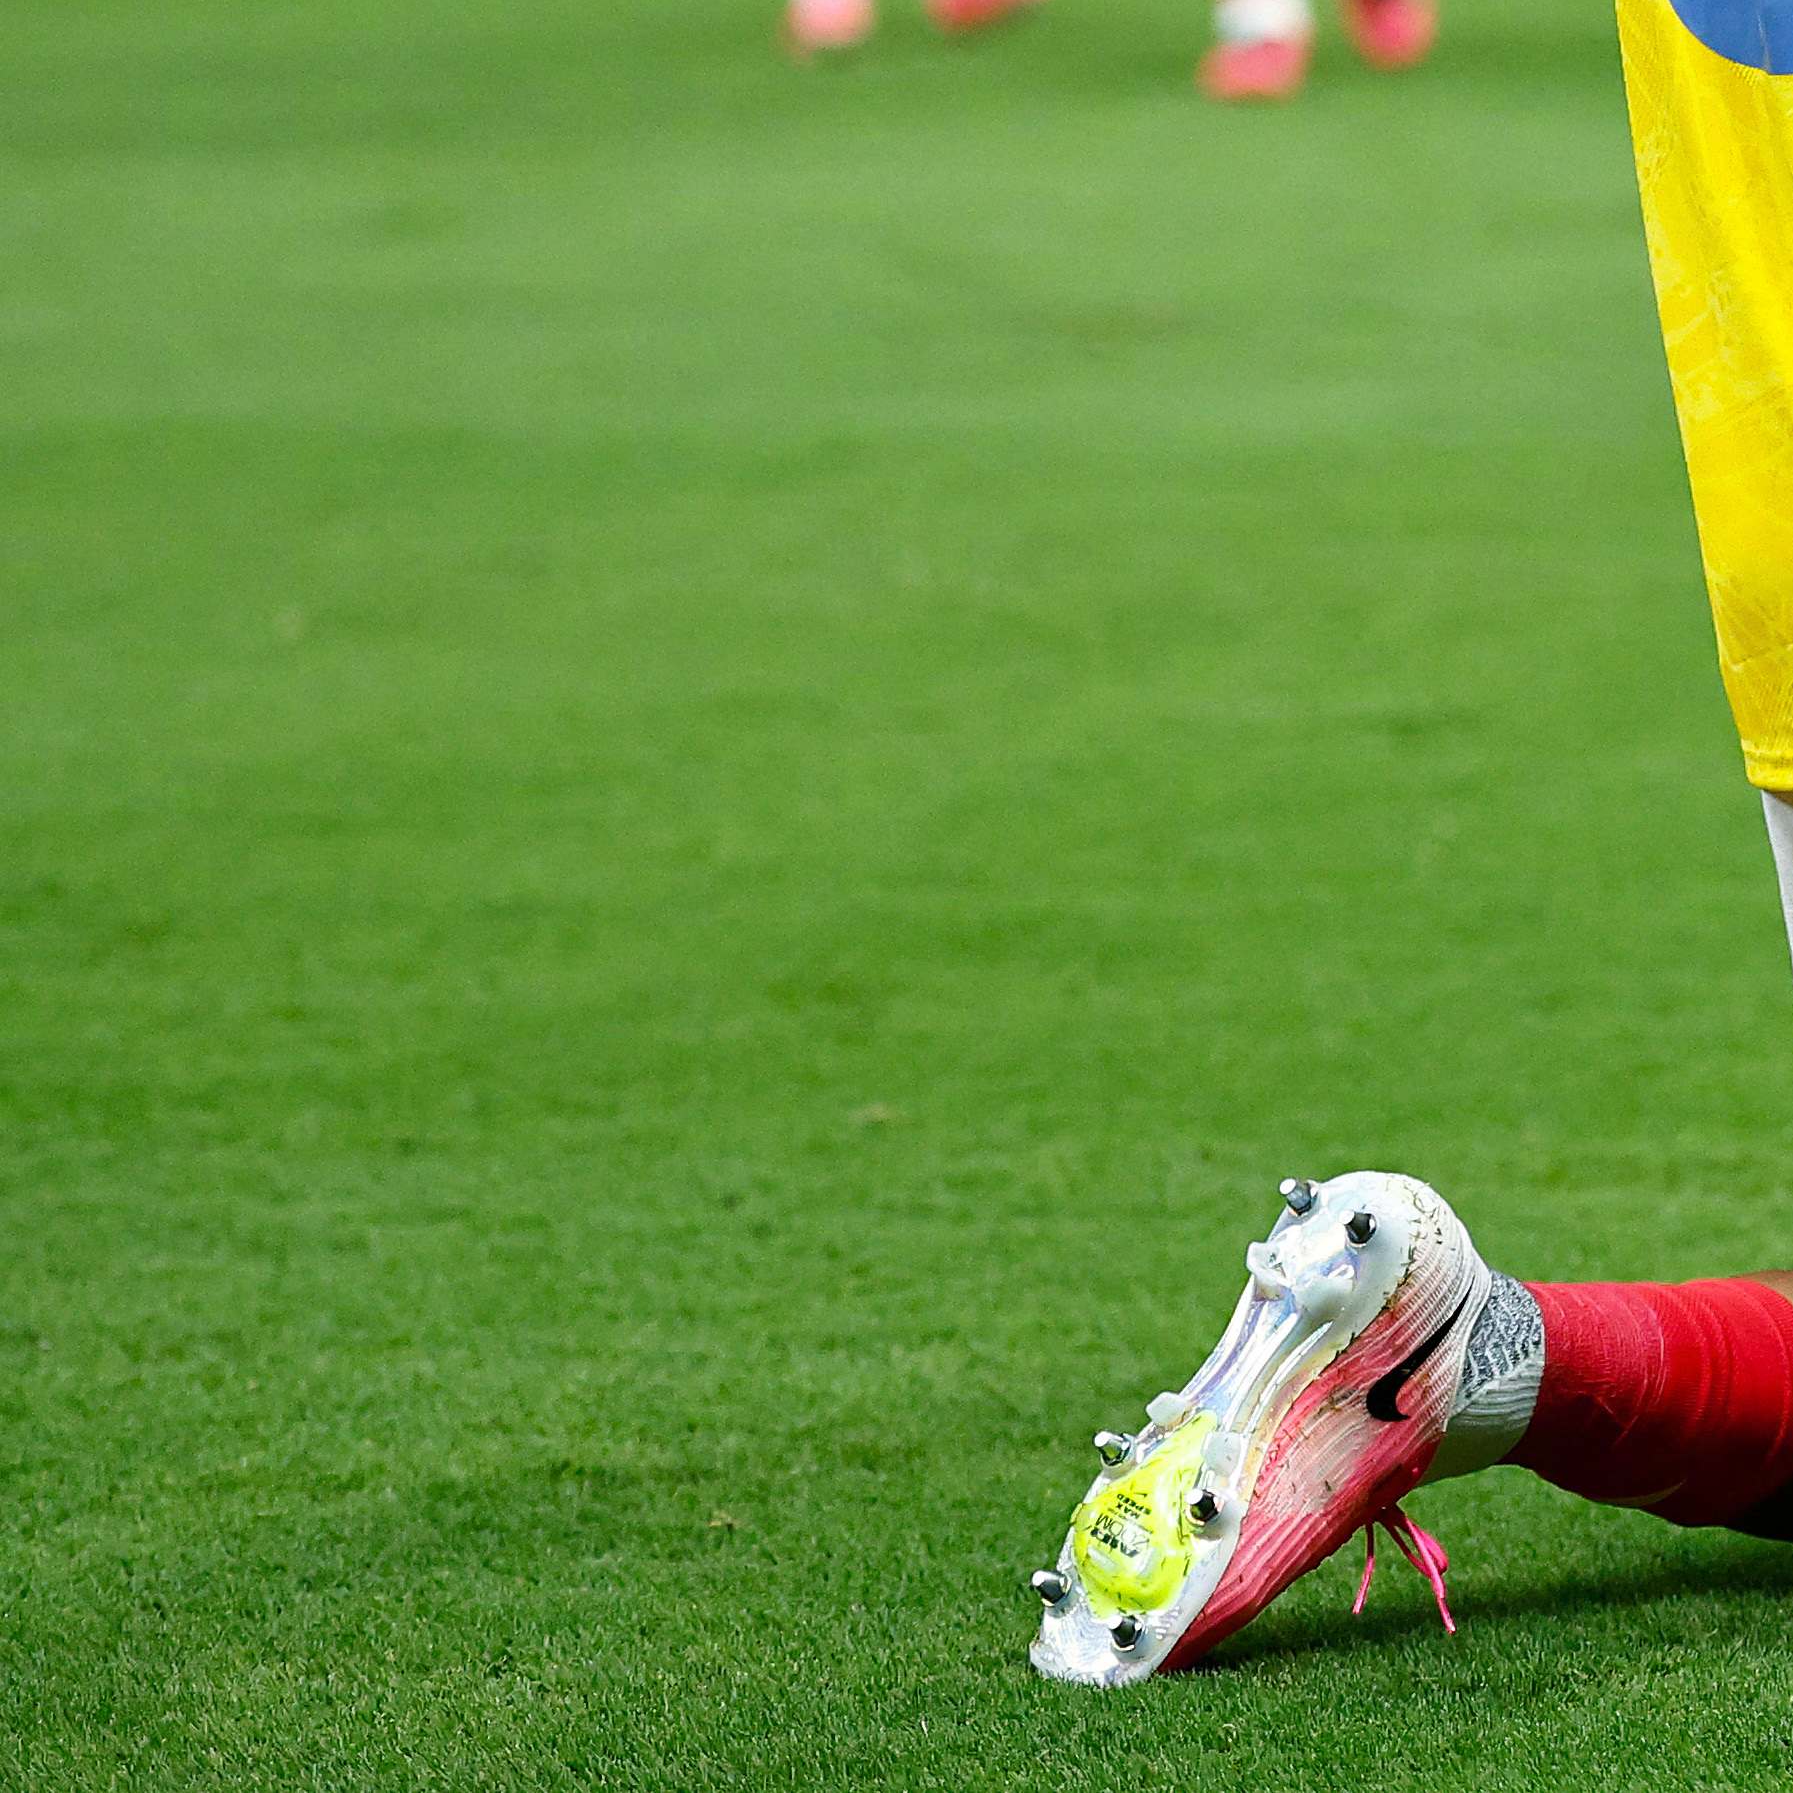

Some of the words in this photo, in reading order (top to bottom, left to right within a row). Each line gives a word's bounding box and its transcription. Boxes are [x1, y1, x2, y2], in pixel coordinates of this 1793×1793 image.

[1115, 1502, 1141, 1519] MAX
[1116, 1493, 1152, 1515] SPEED
[1095, 1513, 1151, 1551] ZOOM
